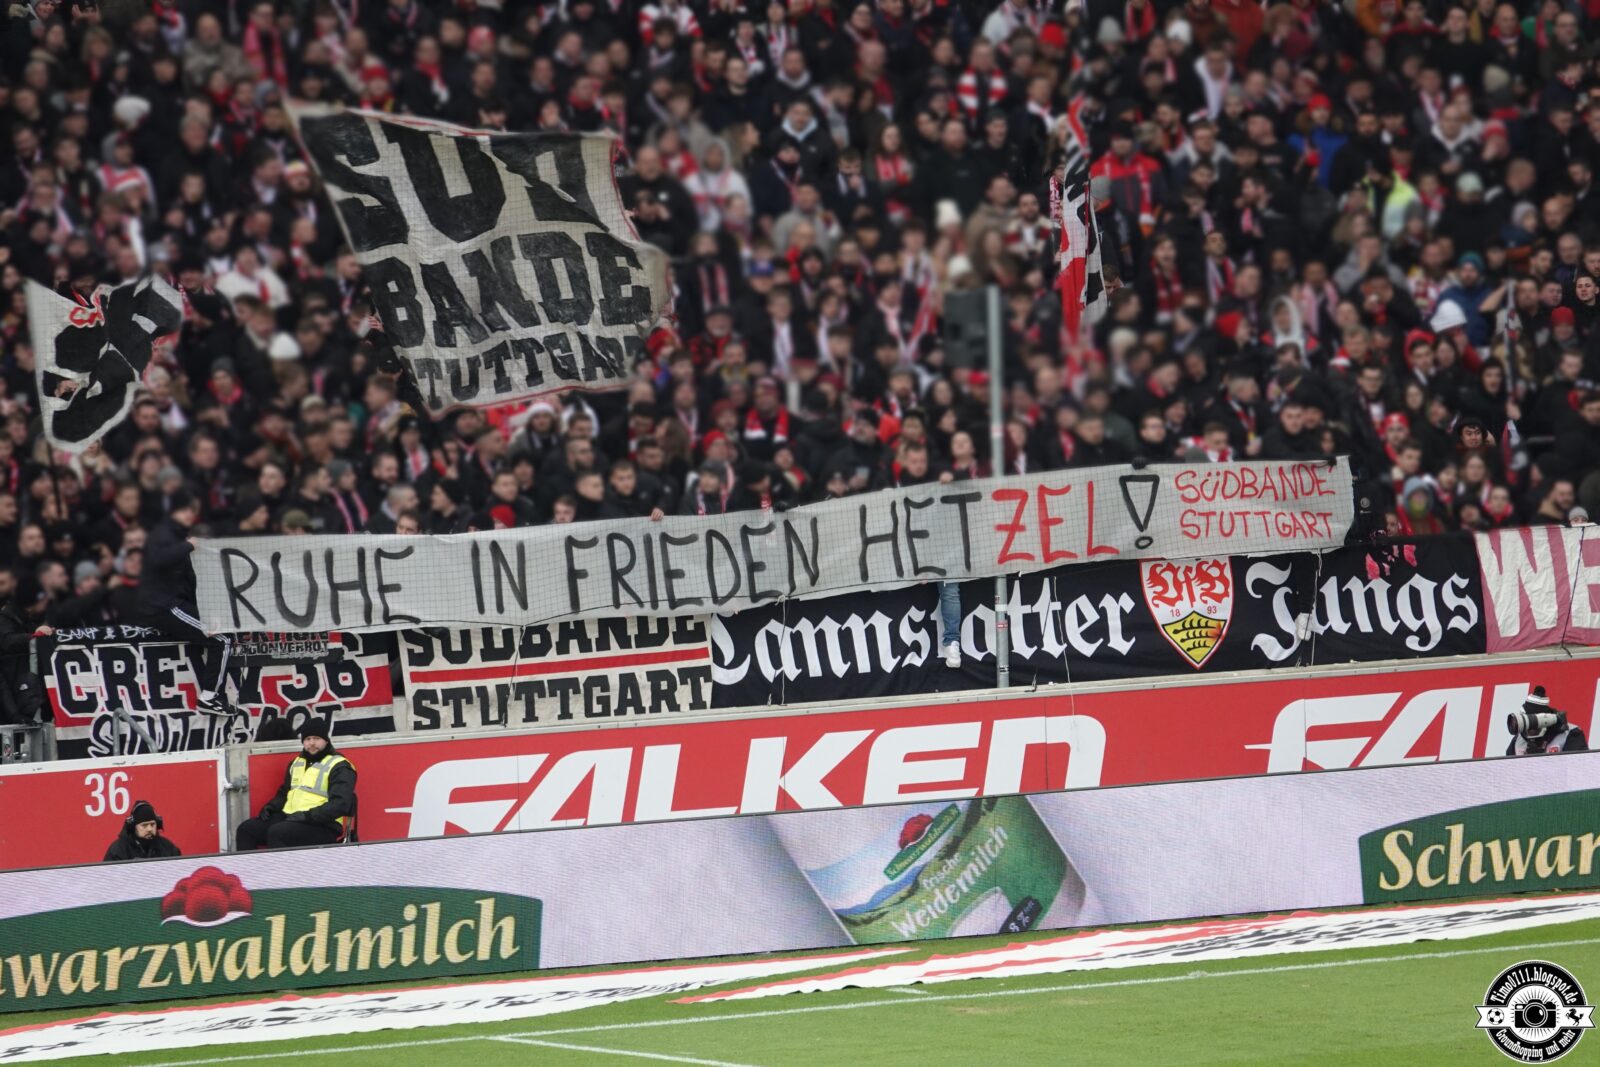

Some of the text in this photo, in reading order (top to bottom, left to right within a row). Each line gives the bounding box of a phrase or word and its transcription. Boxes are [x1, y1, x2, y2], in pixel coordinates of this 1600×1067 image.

[364, 231, 652, 348] BANDE
[1174, 464, 1336, 503] SÜDBANDE
[1180, 508, 1333, 540] STUTTGART
[219, 545, 421, 628] RUHE
[470, 539, 530, 615] IN
[565, 515, 820, 613] FRIEDEN
[1146, 559, 1230, 609] VfB
[1170, 605, 1217, 618] 18 93
[412, 664, 712, 731] STUTTGART
[84, 771, 131, 817] 36
[384, 714, 1107, 838] FALKEN
[890, 825, 1009, 938] Weidemilch
[0, 897, 520, 998] warzwaldmilch
